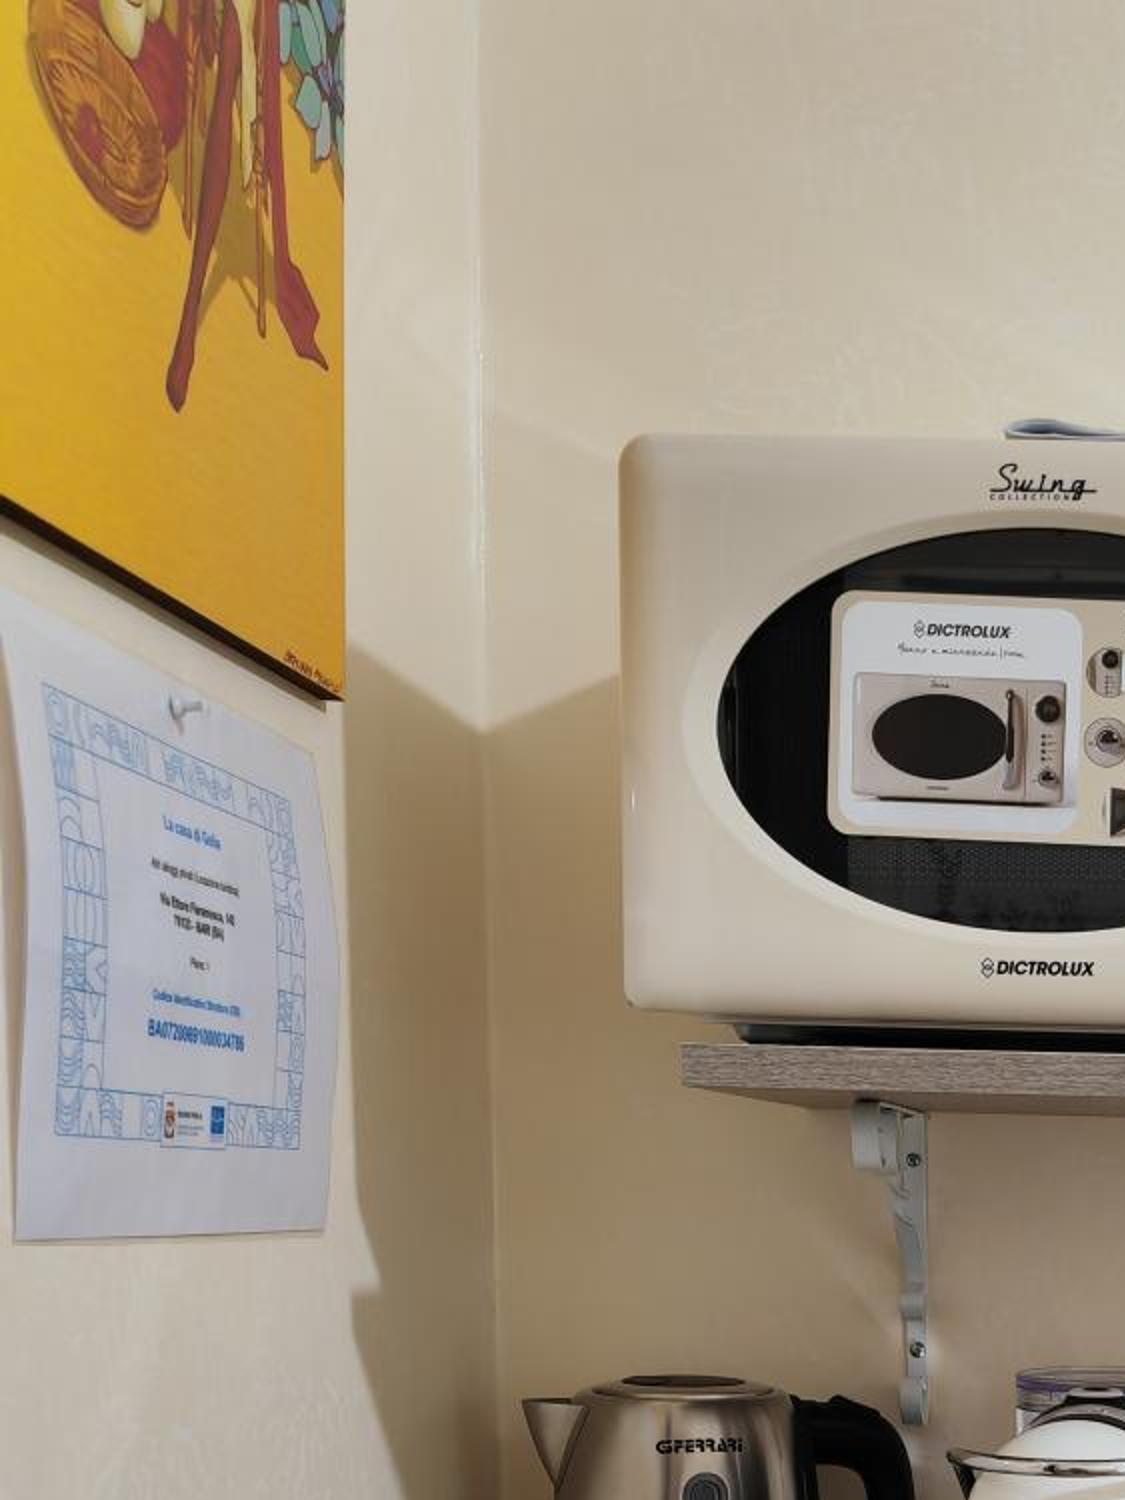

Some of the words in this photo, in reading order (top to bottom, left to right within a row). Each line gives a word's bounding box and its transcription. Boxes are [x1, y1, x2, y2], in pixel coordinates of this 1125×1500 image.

[990, 463, 1097, 501] Swing
[927, 623, 1011, 639] DICTROLUX
[997, 960, 1095, 977] DICTROLUX
